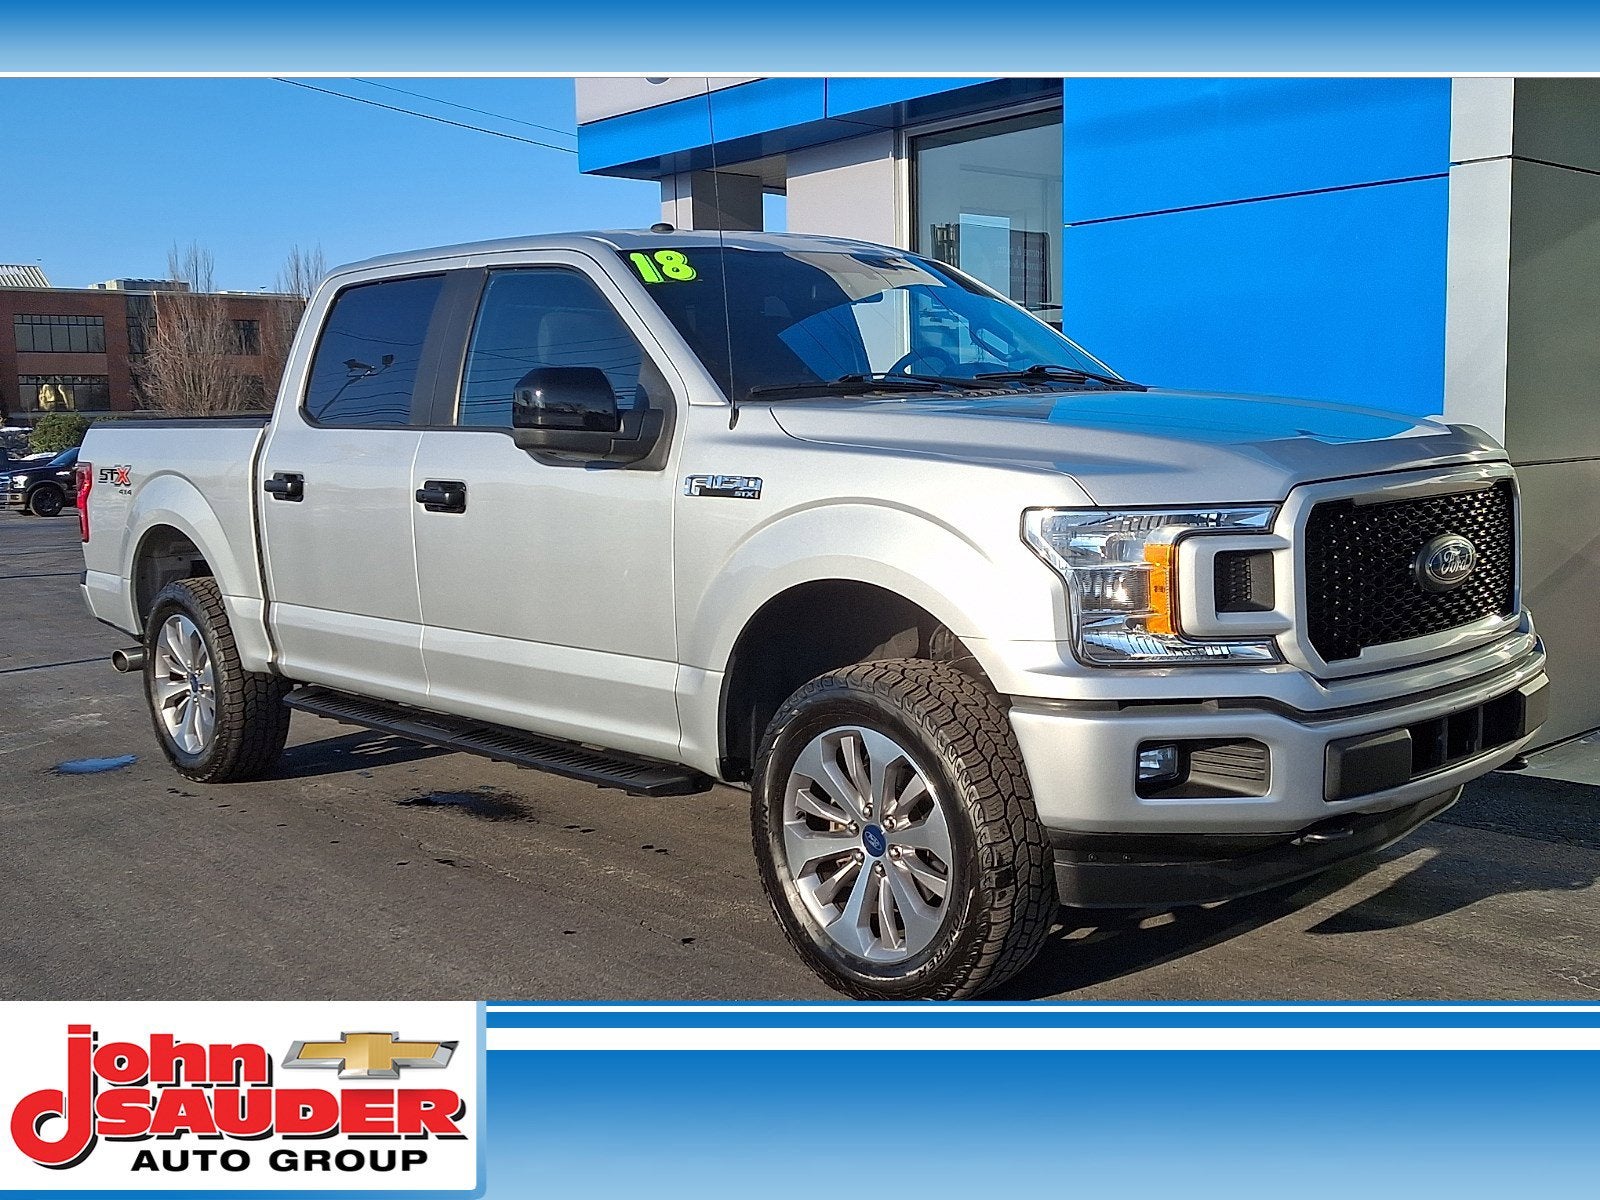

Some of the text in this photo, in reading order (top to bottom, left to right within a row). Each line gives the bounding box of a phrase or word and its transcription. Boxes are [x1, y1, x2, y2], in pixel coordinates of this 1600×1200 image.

[629, 250, 697, 283] 18
[98, 465, 132, 486] STX
[1441, 547, 1470, 575] Ford
